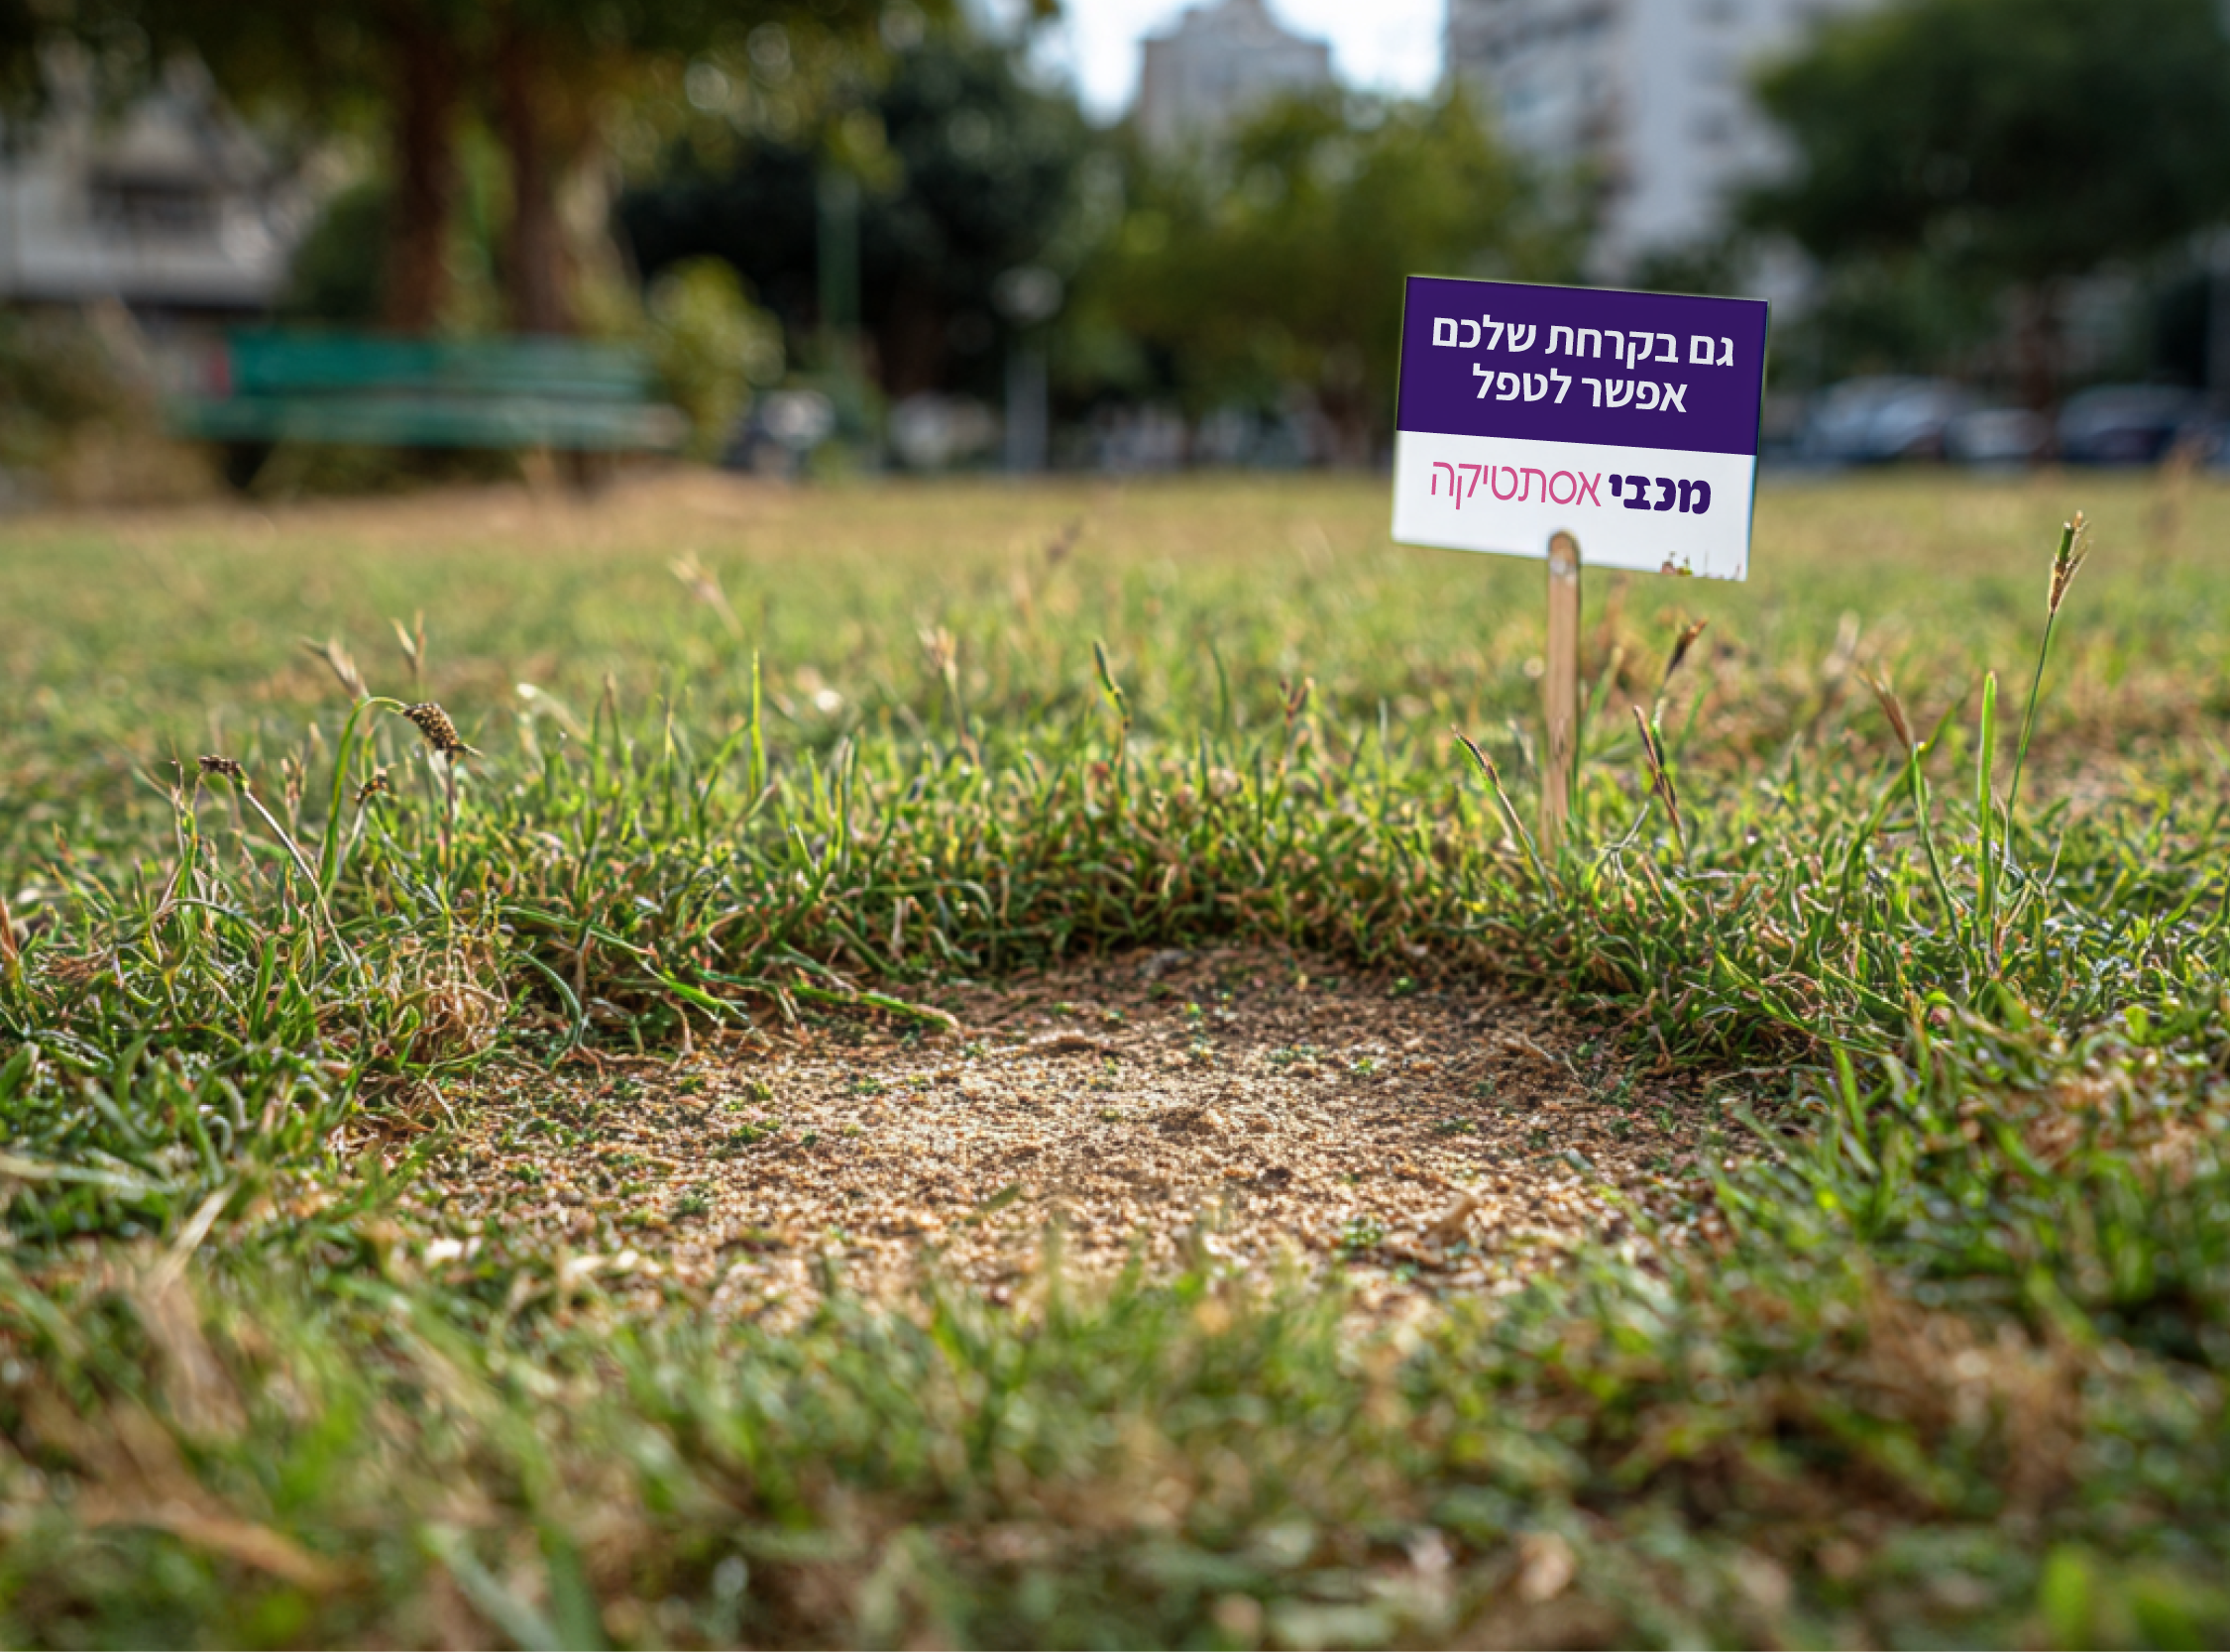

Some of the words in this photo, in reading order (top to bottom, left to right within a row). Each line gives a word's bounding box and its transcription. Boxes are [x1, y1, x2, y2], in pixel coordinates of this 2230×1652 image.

[1432, 314, 1537, 353] שלכם
[1544, 325, 1679, 370] בקרחת
[1689, 335, 1734, 367] גם
[1472, 363, 1572, 404] לטפל
[1581, 378, 1688, 413] אפשר
[1430, 461, 1602, 510] אסתטיקה
[1608, 473, 1712, 515] מכבי
